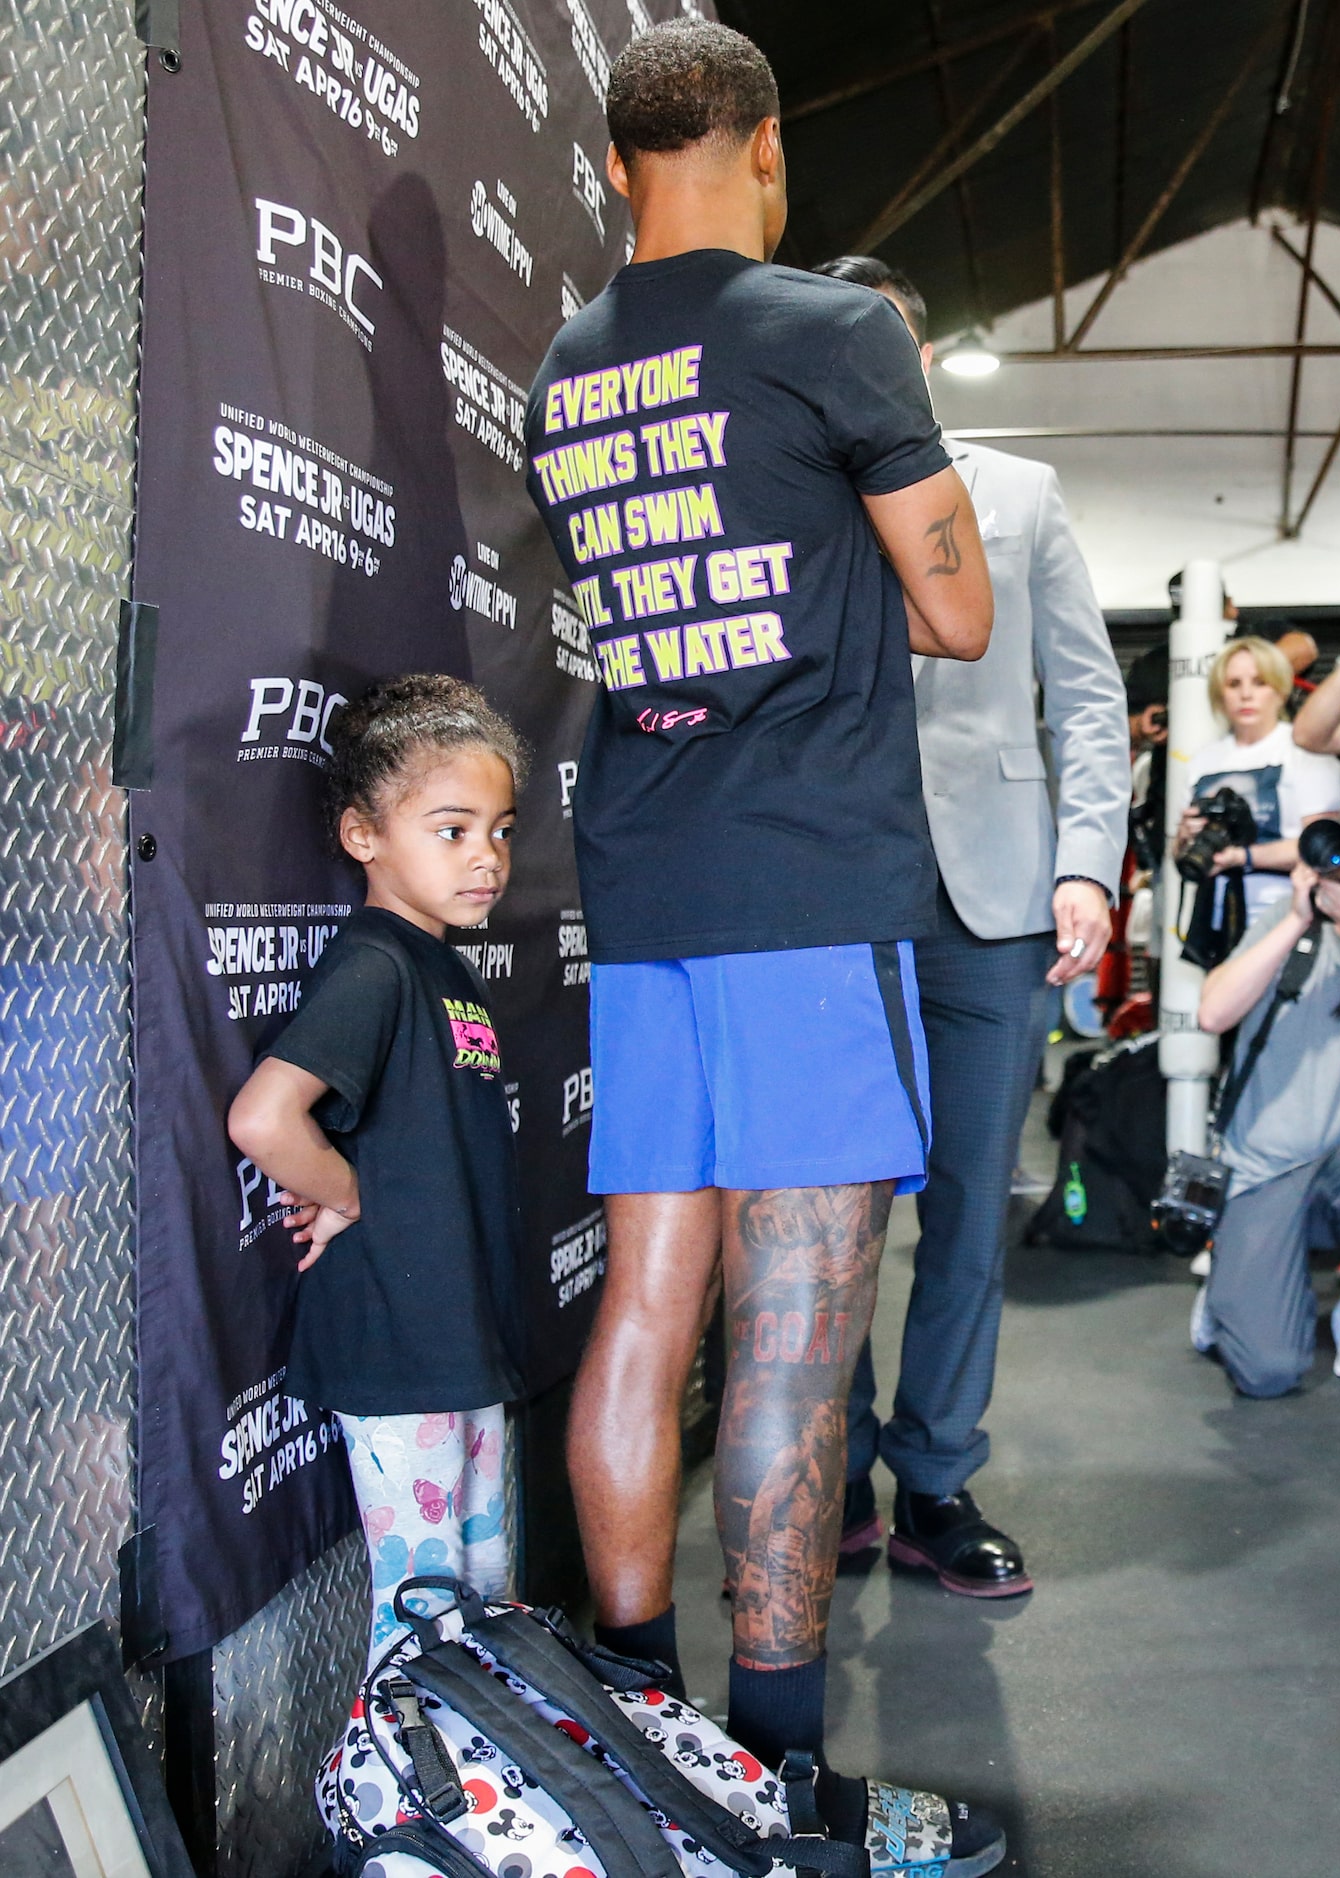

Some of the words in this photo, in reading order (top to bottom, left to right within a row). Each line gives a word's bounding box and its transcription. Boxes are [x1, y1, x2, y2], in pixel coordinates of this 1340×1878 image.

[245, 15, 290, 72] SAT
[330, 25, 356, 85] JR
[363, 57, 420, 139] UGAS
[369, 35, 420, 89] CHAMPIONSHIP
[479, 22, 498, 67] SAT
[511, 28, 523, 76] JR
[526, 53, 548, 118] UGAS
[573, 141, 606, 236] PBC
[255, 198, 383, 335] PBC
[258, 267, 304, 292] PREMIER
[309, 283, 337, 311] BOXING
[338, 305, 373, 352] CHAMPIONS
[441, 342, 490, 413] SPENCE
[490, 381, 506, 425] JR
[455, 397, 477, 434] SAT
[545, 344, 702, 435] EVERYONE
[213, 425, 318, 508] SPENCE
[320, 468, 342, 522] JR
[350, 485, 396, 547] UGAS
[220, 402, 264, 431] UNIFIED
[269, 420, 297, 445] WORLD
[298, 434, 349, 473] WELTERWEIGHT
[350, 463, 394, 498] CHAMPIONSHIP
[533, 429, 638, 506] THINKS
[640, 411, 730, 477] THEY
[239, 494, 292, 539] SAT
[477, 541, 490, 565] LIVE
[568, 501, 624, 565] CAN
[624, 483, 725, 550] SWIM
[612, 554, 699, 621] THEY
[705, 541, 793, 605] GET
[595, 633, 648, 693] THE
[645, 610, 793, 683] WATER
[237, 746, 279, 762] PREMIER
[282, 746, 308, 761] BOXING
[241, 677, 349, 756] PBC
[205, 903, 234, 918] UNIFIED
[236, 903, 259, 918] WORLD
[259, 903, 305, 918] WELTERWEIGHT
[306, 903, 352, 917] CHAMPIONSHIP
[206, 926, 276, 976] SPENCE
[277, 926, 299, 971] JR
[442, 997, 493, 1028] MAN
[753, 1311, 851, 1365] GOAT
[243, 1380, 266, 1404] WORLD
[219, 1393, 280, 1480] SPENCE
